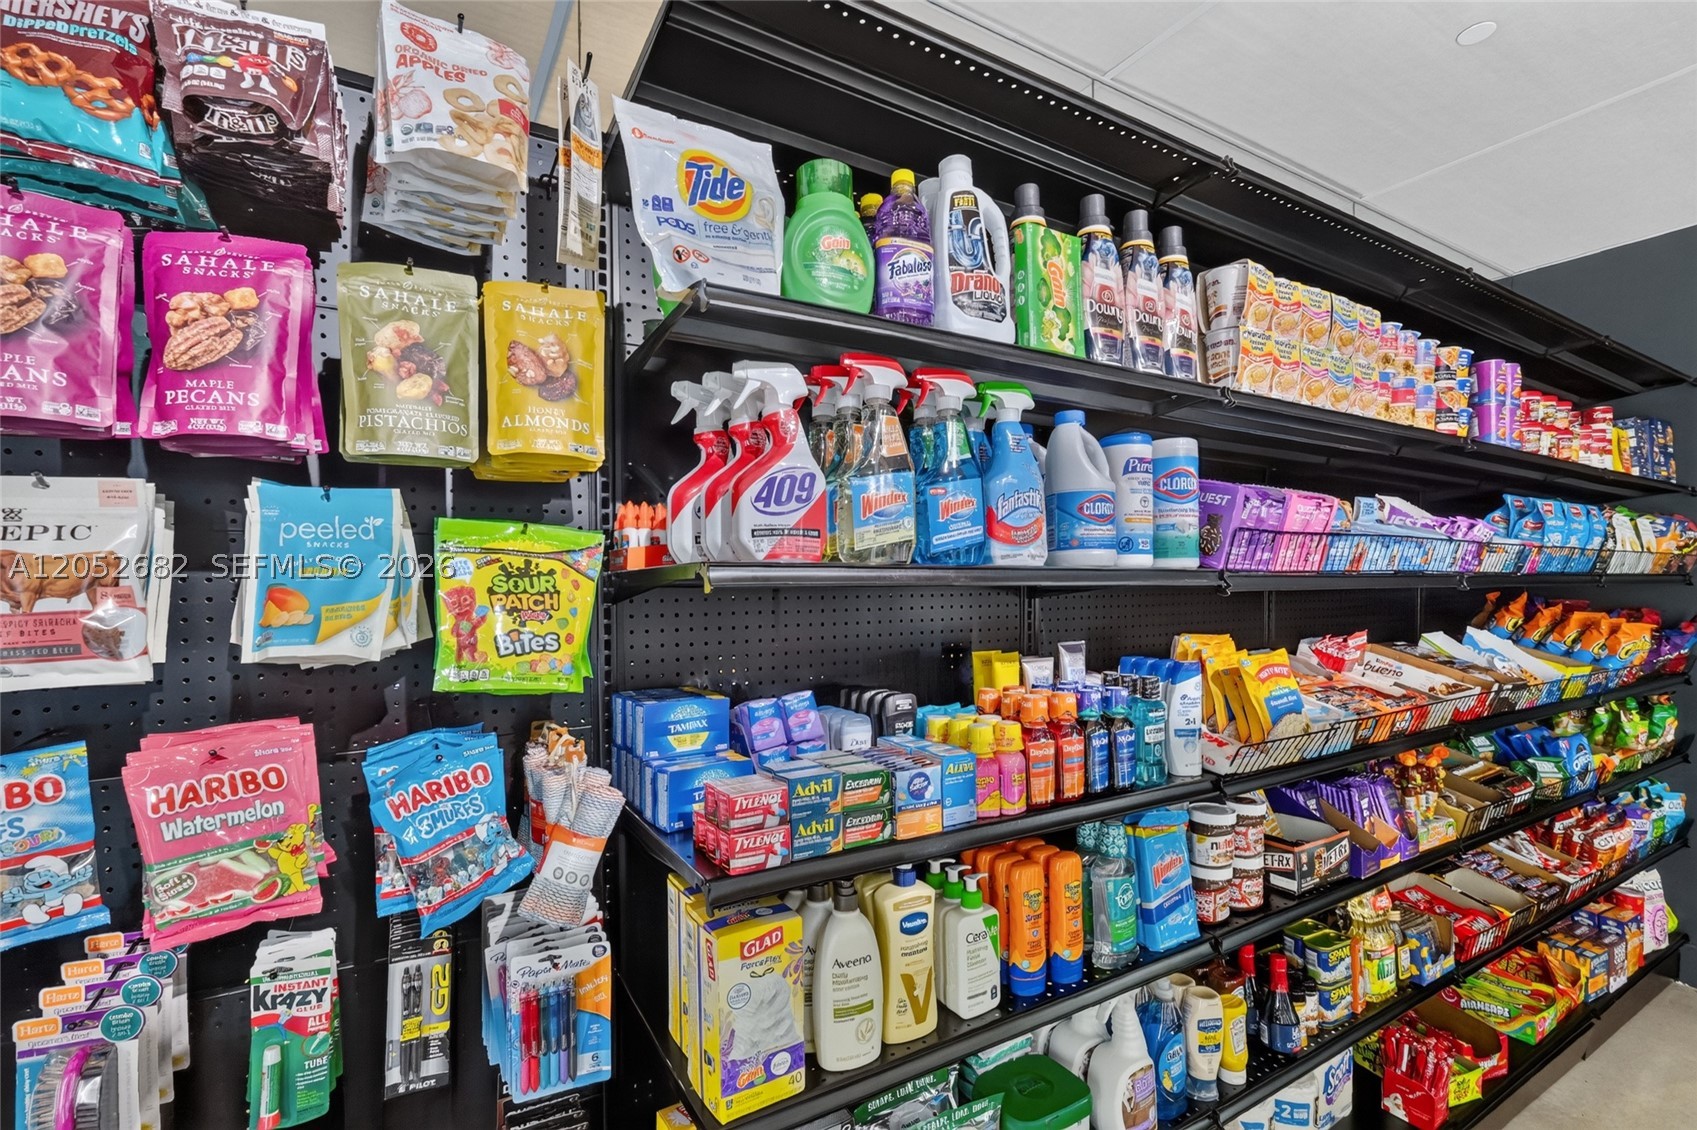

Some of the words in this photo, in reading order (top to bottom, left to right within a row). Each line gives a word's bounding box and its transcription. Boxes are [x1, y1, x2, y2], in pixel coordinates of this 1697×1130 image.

[0, 0, 149, 43] HERSHEY'S
[395, 44, 449, 71] ORGANIC
[451, 63, 489, 77] DRIED
[395, 53, 467, 84] APPLES
[684, 160, 746, 207] Tide
[656, 215, 697, 236] PODS
[703, 221, 729, 234] free
[731, 224, 743, 236] &
[820, 235, 851, 250] Gain
[160, 253, 277, 273] SAHALE
[182, 266, 254, 279] SNACKS
[950, 270, 1002, 294] Drano
[1047, 260, 1066, 309] Gain
[358, 284, 458, 314] SAHALE
[380, 301, 442, 318] SNACKS
[501, 300, 588, 323] SAHALE
[1086, 298, 1124, 324] Downy
[184, 378, 235, 390] MAPLE
[164, 389, 260, 408] PECANS
[527, 405, 567, 416] HONEY
[358, 414, 469, 438] PISTACHIOS
[501, 414, 592, 435] ALMONDS
[754, 472, 817, 509] 409
[1200, 492, 1233, 508] UEST
[860, 489, 910, 521] Windex
[939, 498, 979, 523] Windex
[0, 524, 93, 542] EPIC
[278, 515, 385, 547] peeled
[306, 541, 350, 549] SNACKS
[491, 574, 557, 595] SOUR
[489, 593, 560, 613] PATCH
[19, 628, 57, 638] BITES
[32, 618, 78, 628] SRIRACHA
[1363, 660, 1404, 678] bueno
[667, 718, 709, 734] TAMPAX
[149, 765, 286, 818] HARIBO
[387, 763, 493, 820] HARIBO
[793, 778, 833, 799] Advil
[734, 789, 783, 813] TYLENOL
[160, 799, 286, 842] Watermelon
[416, 796, 485, 840] SMURFS
[794, 817, 836, 839] Advil
[734, 830, 786, 852] TYLENOL
[1263, 854, 1291, 868] ET-Rx
[1151, 856, 1185, 889] Windex
[742, 929, 783, 959] GLAD
[740, 953, 783, 972] ForceFlex
[273, 977, 329, 994] INSTANT
[45, 990, 81, 1005] Hartz
[295, 1003, 323, 1014] GLUE
[1459, 998, 1511, 1019] AIRHEADS
[19, 1022, 57, 1038] Hartz
[307, 1015, 328, 1028] ALL
[303, 1055, 328, 1070] TUBE
[591, 1052, 600, 1061] 6
[408, 1078, 436, 1091] PILOT
[736, 1064, 764, 1089] Gain
[788, 1070, 803, 1086] 40
[1280, 1103, 1292, 1120] 2
